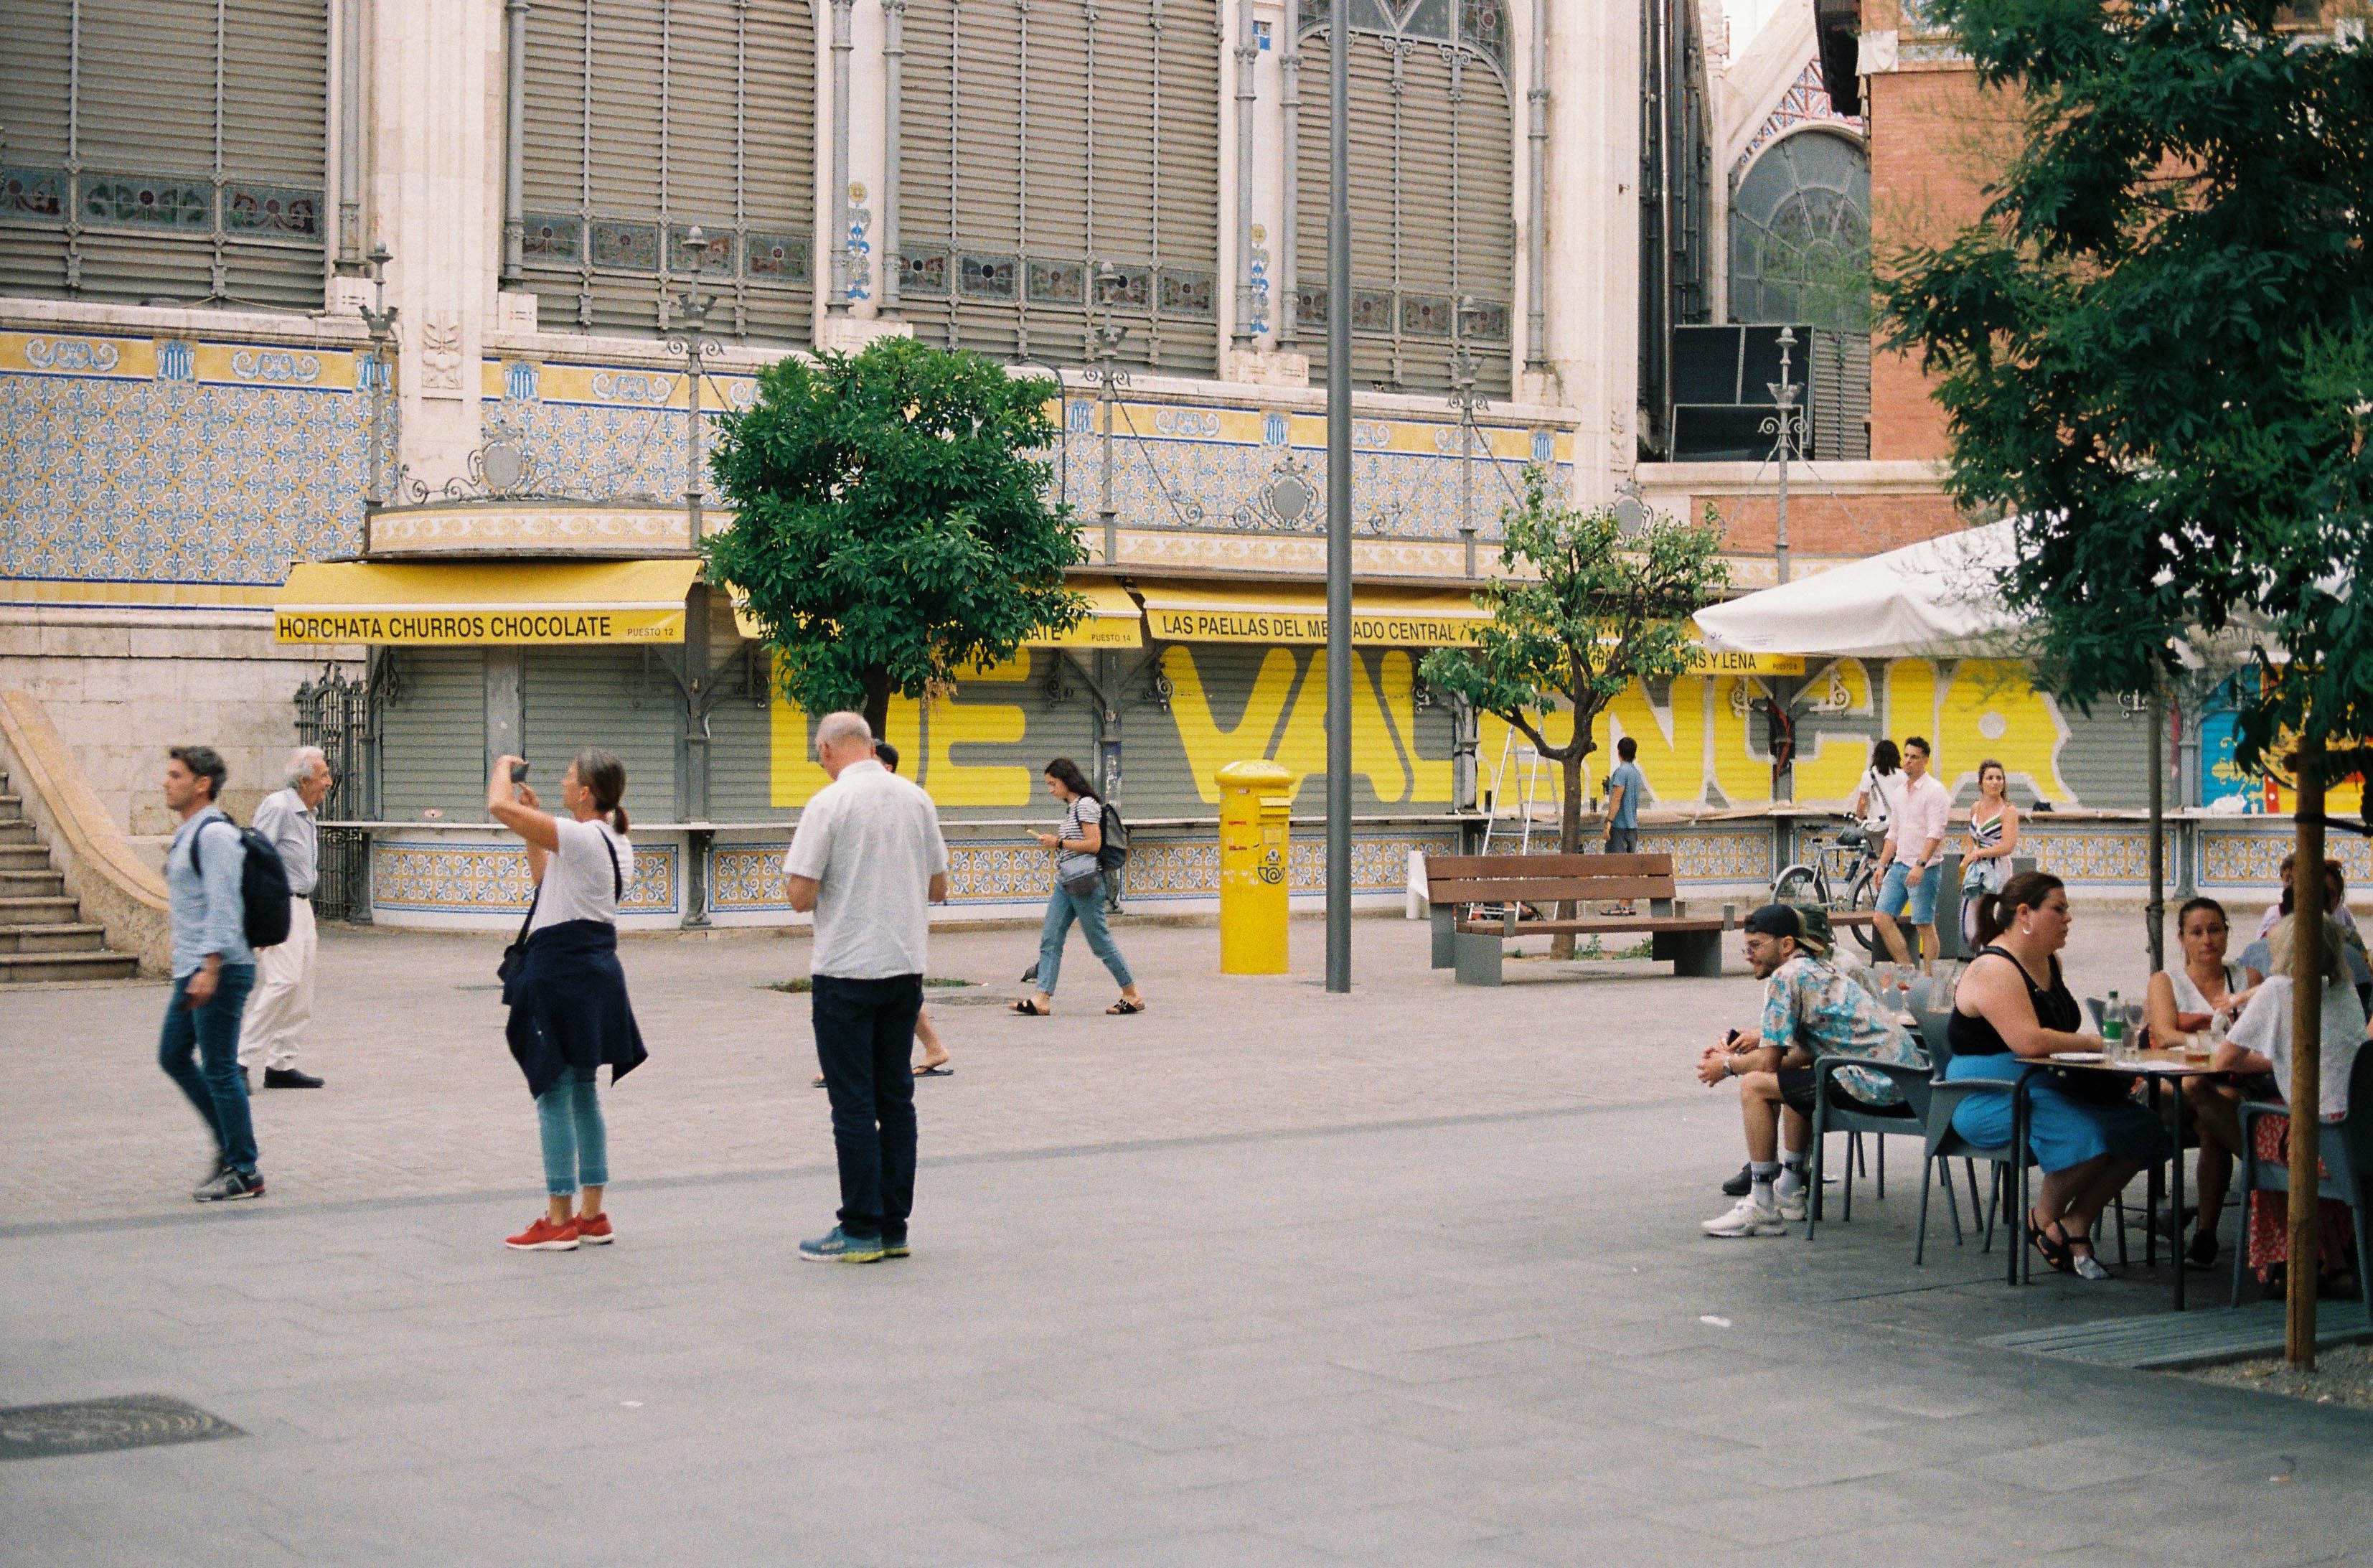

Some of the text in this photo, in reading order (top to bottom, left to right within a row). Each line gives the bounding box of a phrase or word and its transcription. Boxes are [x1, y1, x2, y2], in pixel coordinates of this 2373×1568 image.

[278, 616, 611, 639] HORCHATA CHURROS CHOCOLATE
[628, 628, 661, 637] PUESTO
[1162, 616, 1456, 641] LAS PAELLAS DEL MEADO CENTRAL
[1710, 653, 1718, 668] Y
